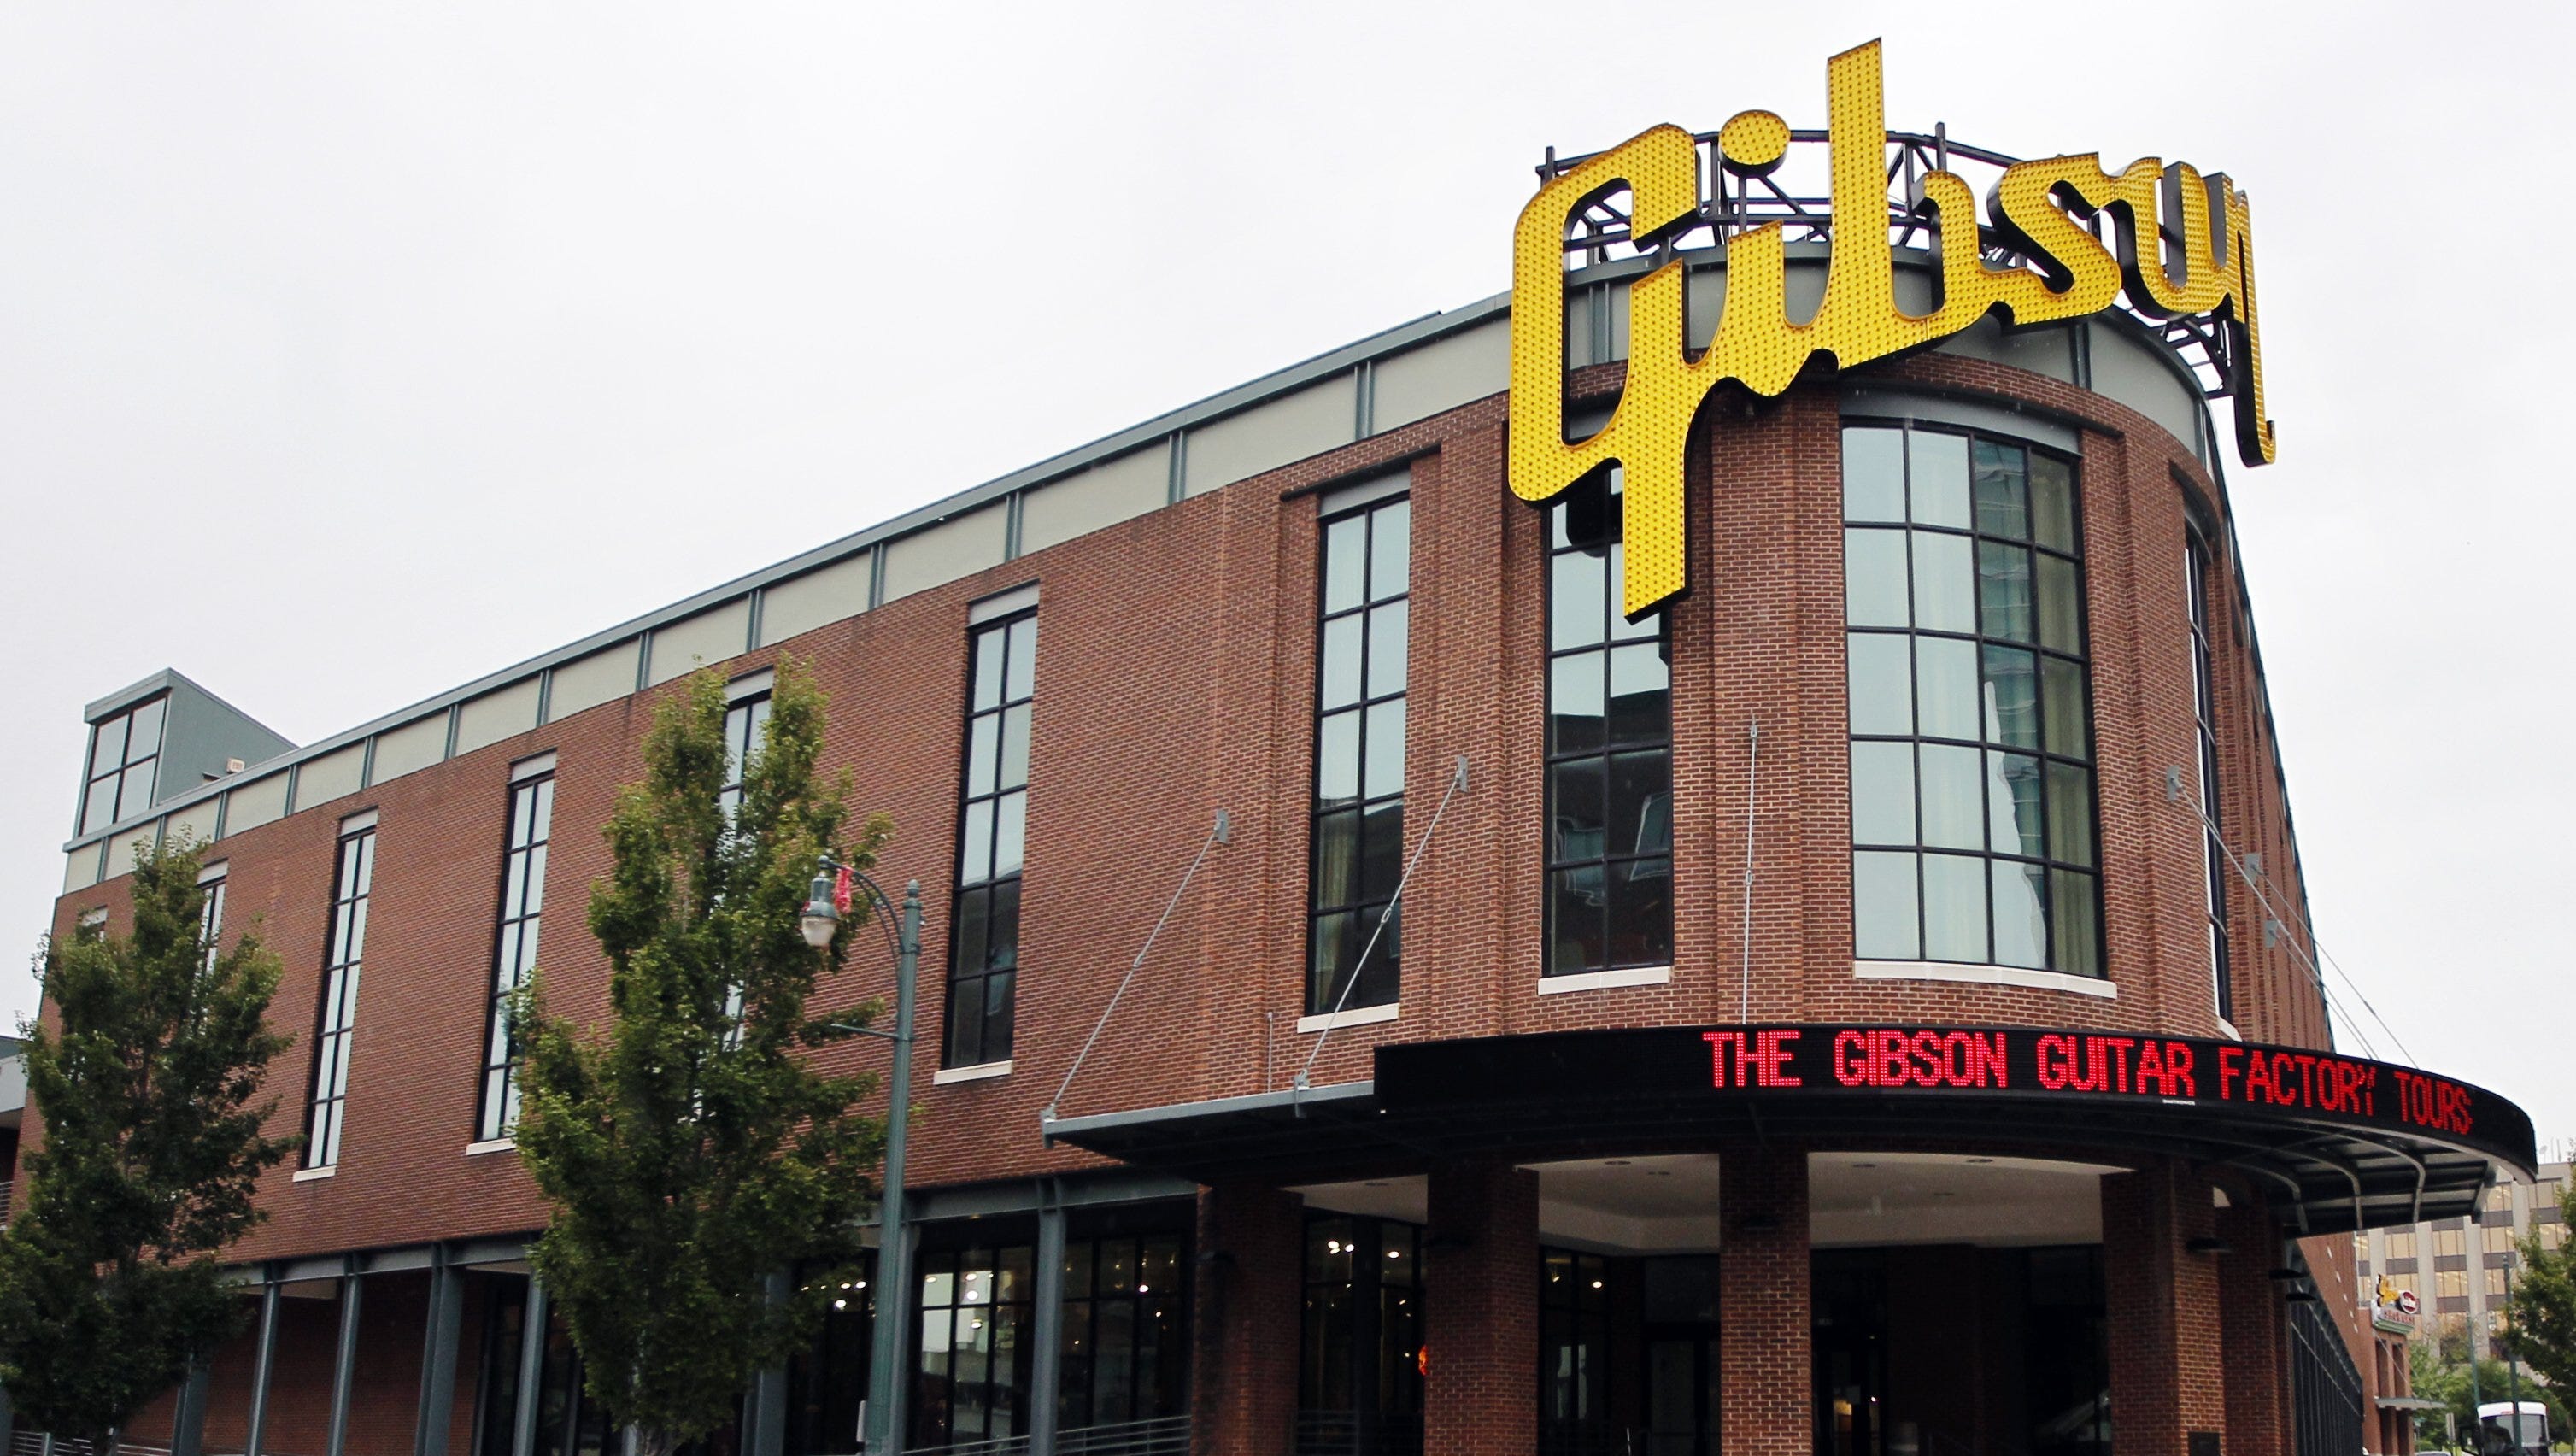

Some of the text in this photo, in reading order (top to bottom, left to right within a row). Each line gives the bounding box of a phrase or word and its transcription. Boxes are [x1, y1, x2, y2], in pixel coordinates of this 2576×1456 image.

[1508, 38, 2276, 625] Gibson
[1703, 1030, 2472, 1135] THE GIBSON GUITAR FACTORY TOURS
